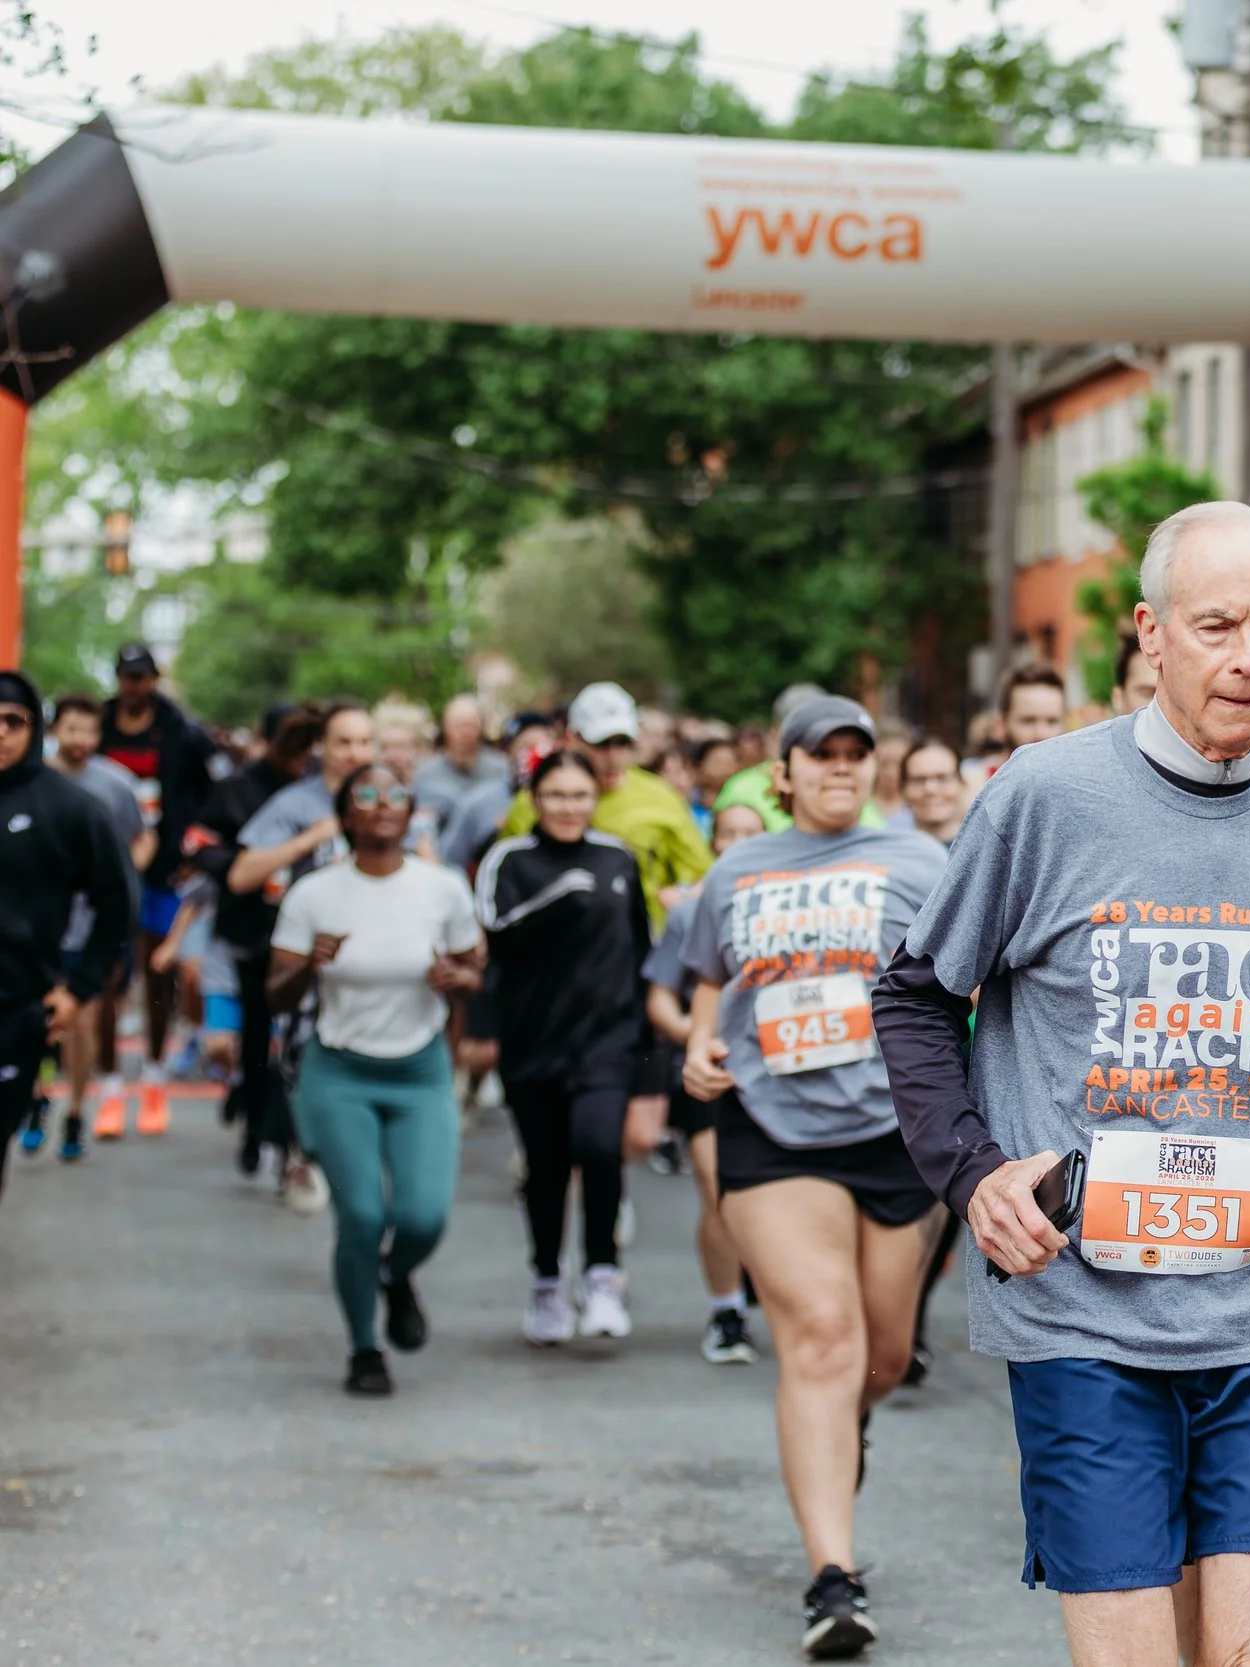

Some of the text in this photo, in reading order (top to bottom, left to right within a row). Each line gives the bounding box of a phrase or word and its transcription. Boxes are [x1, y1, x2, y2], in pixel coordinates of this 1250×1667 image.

[704, 205, 925, 271] ywca
[1090, 901, 1127, 923] 28
[1133, 901, 1212, 924] Years
[1090, 928, 1122, 1059] ywca
[776, 1013, 849, 1051] 945
[1086, 1064, 1179, 1093] APRIL
[1187, 1066, 1240, 1096] 25,
[1159, 1143, 1168, 1172] ywca
[1169, 1145, 1216, 1161] race
[1167, 1162, 1215, 1176] RACISM
[1122, 1190, 1242, 1243] 1351
[1094, 1250, 1122, 1260] ywca
